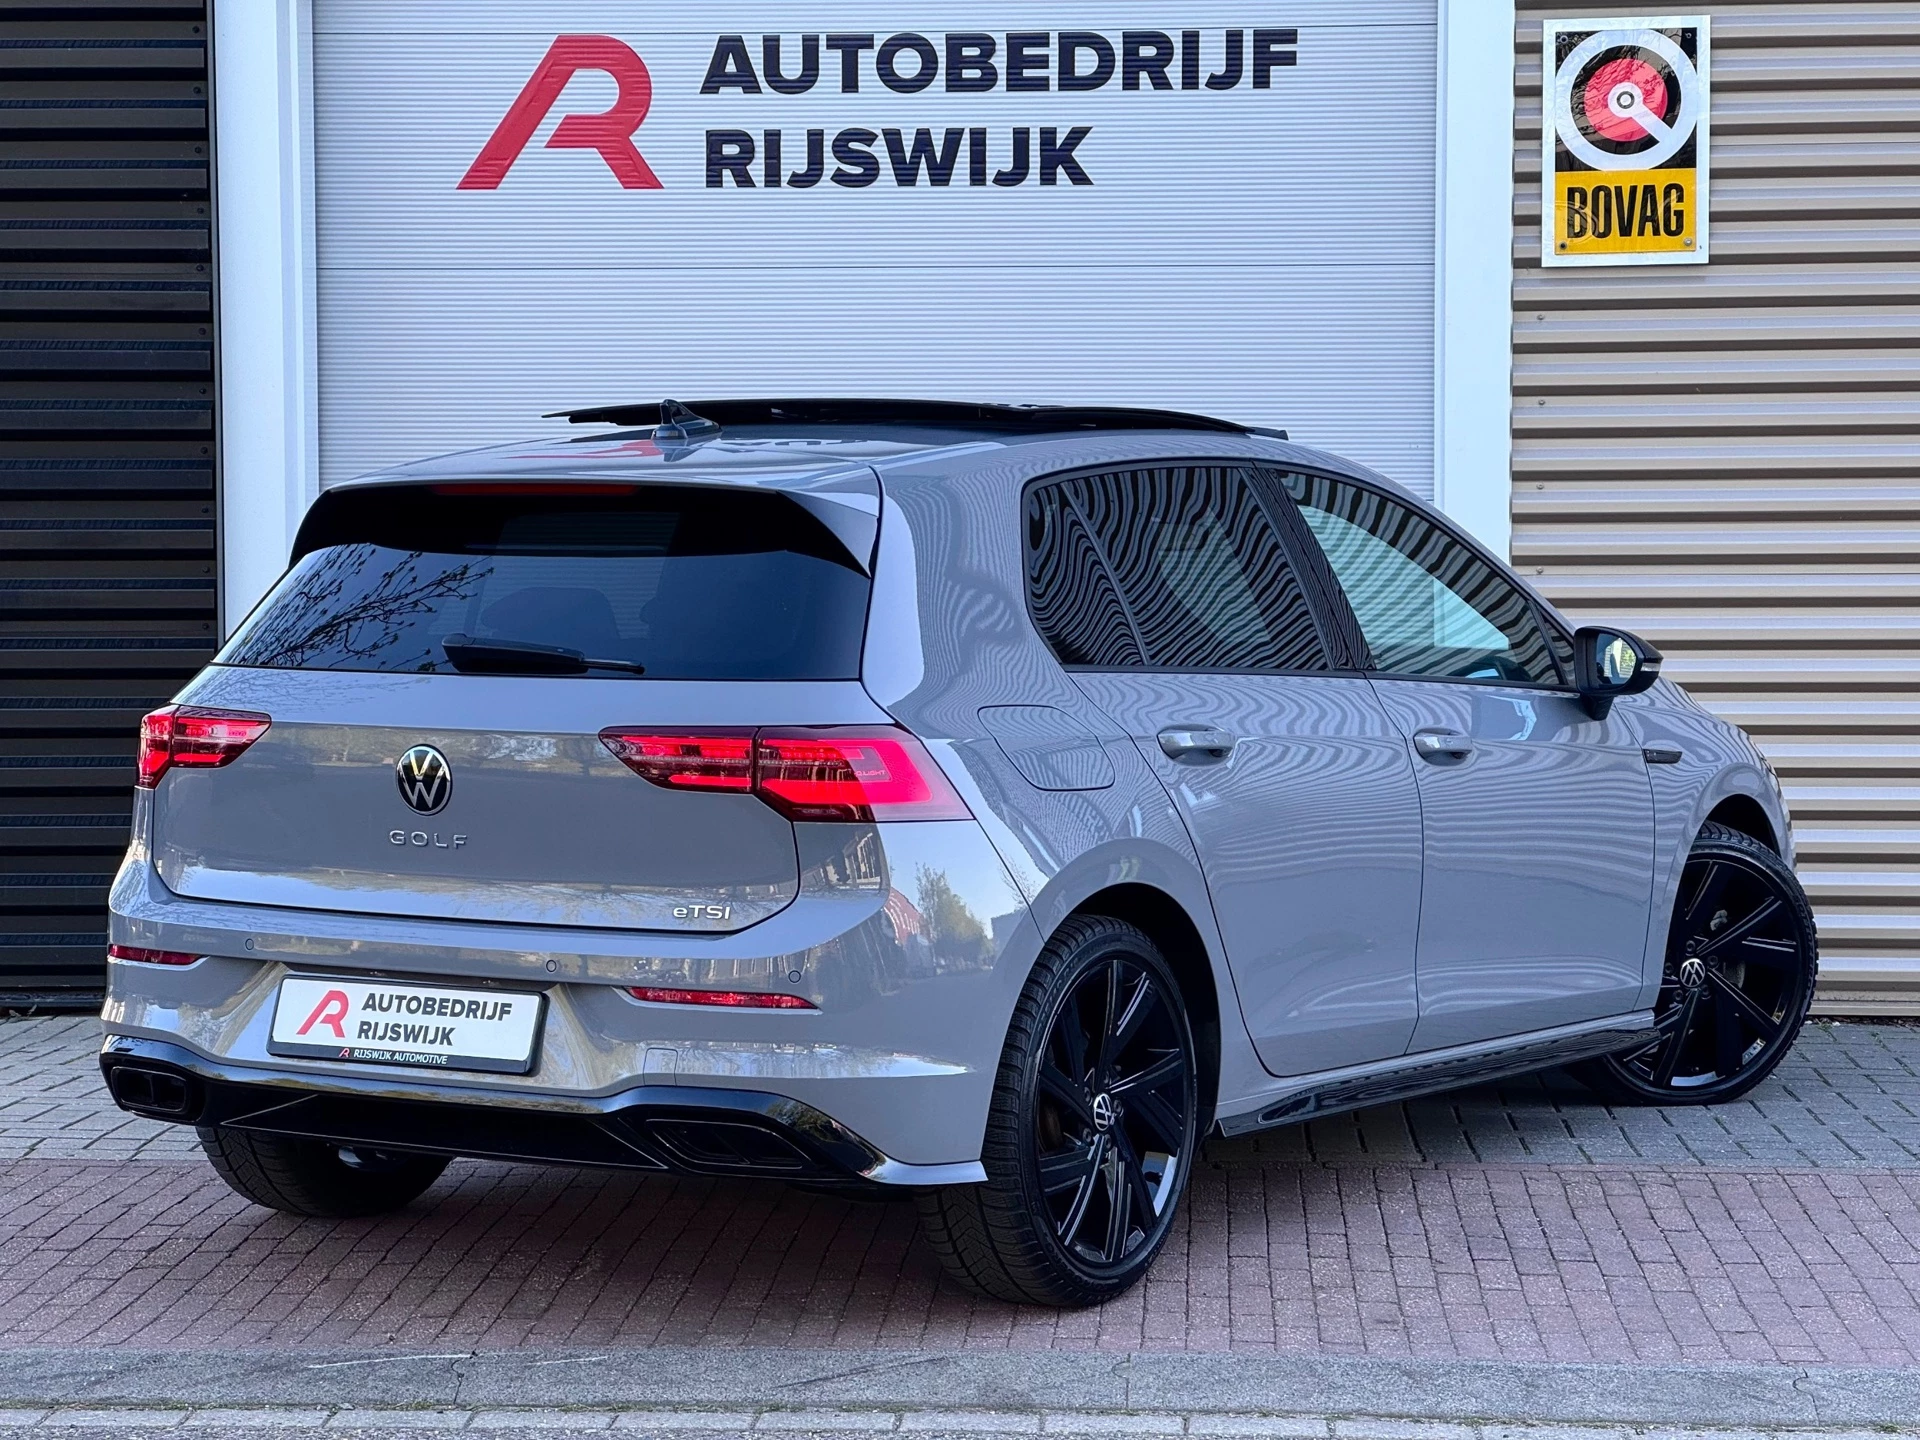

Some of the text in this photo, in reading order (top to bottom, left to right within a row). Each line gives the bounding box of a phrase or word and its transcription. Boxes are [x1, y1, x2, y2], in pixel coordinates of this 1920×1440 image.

[699, 28, 1298, 95] AUTOBEDRIJF
[705, 126, 1094, 189] RIJSWIJK
[1566, 183, 1685, 239] BOVAG
[389, 829, 467, 849] GOLF
[673, 904, 731, 920] eTSI
[361, 992, 513, 1021] AUTOBEDRIJF
[356, 1020, 456, 1047] RIJSWIJK
[353, 1048, 448, 1065] RIJSWIJK AUTOMOTIVE
